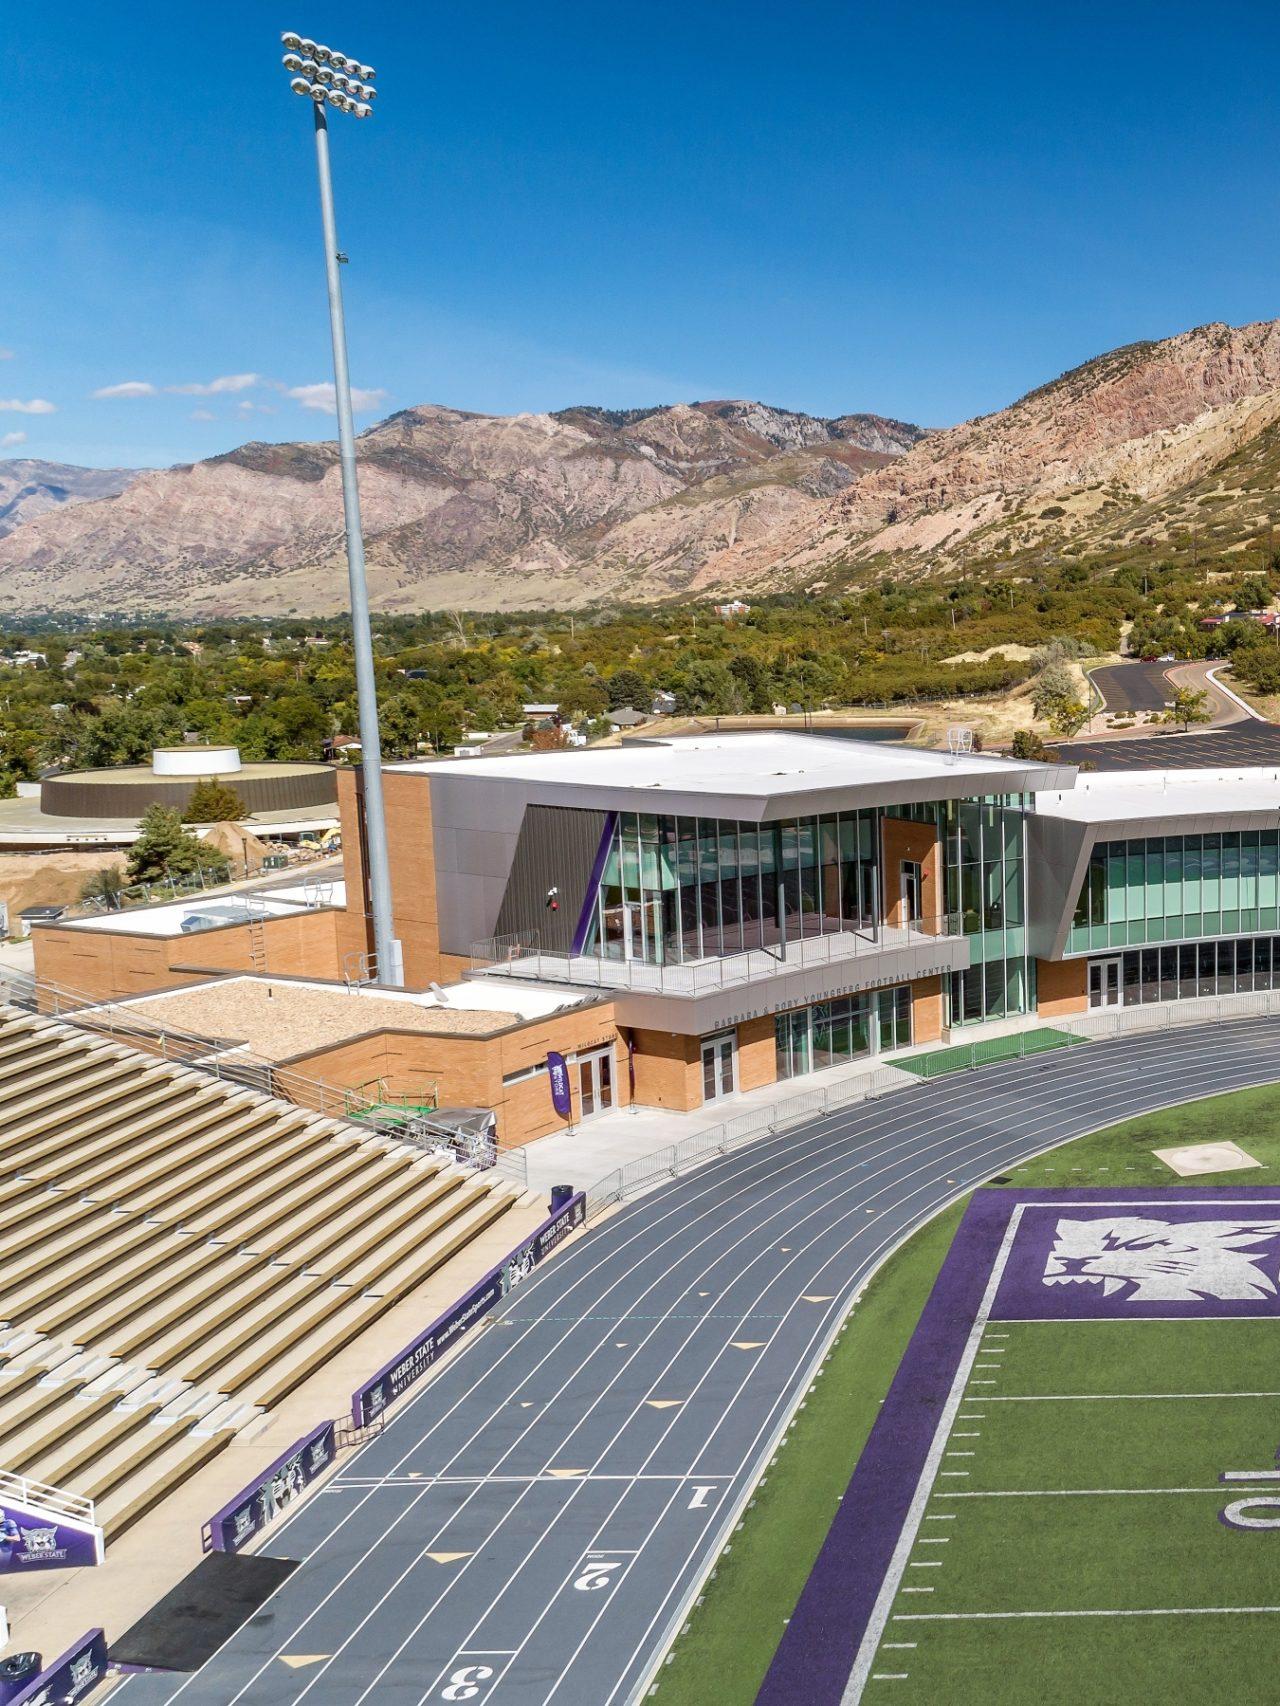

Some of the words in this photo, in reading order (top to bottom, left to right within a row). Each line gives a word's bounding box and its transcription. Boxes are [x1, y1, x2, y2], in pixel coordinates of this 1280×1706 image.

[714, 1009, 758, 1029] BARBARA
[865, 972, 911, 989] FOOTBALL
[916, 964, 952, 980] CENTER
[540, 1224, 557, 1246] WEBER
[556, 1212, 570, 1233] STATE
[390, 1356, 414, 1384] WEBER
[415, 1337, 434, 1365] STATE
[687, 1486, 717, 1509] 1
[573, 1562, 622, 1591] 2
[441, 1665, 494, 1701] 3
